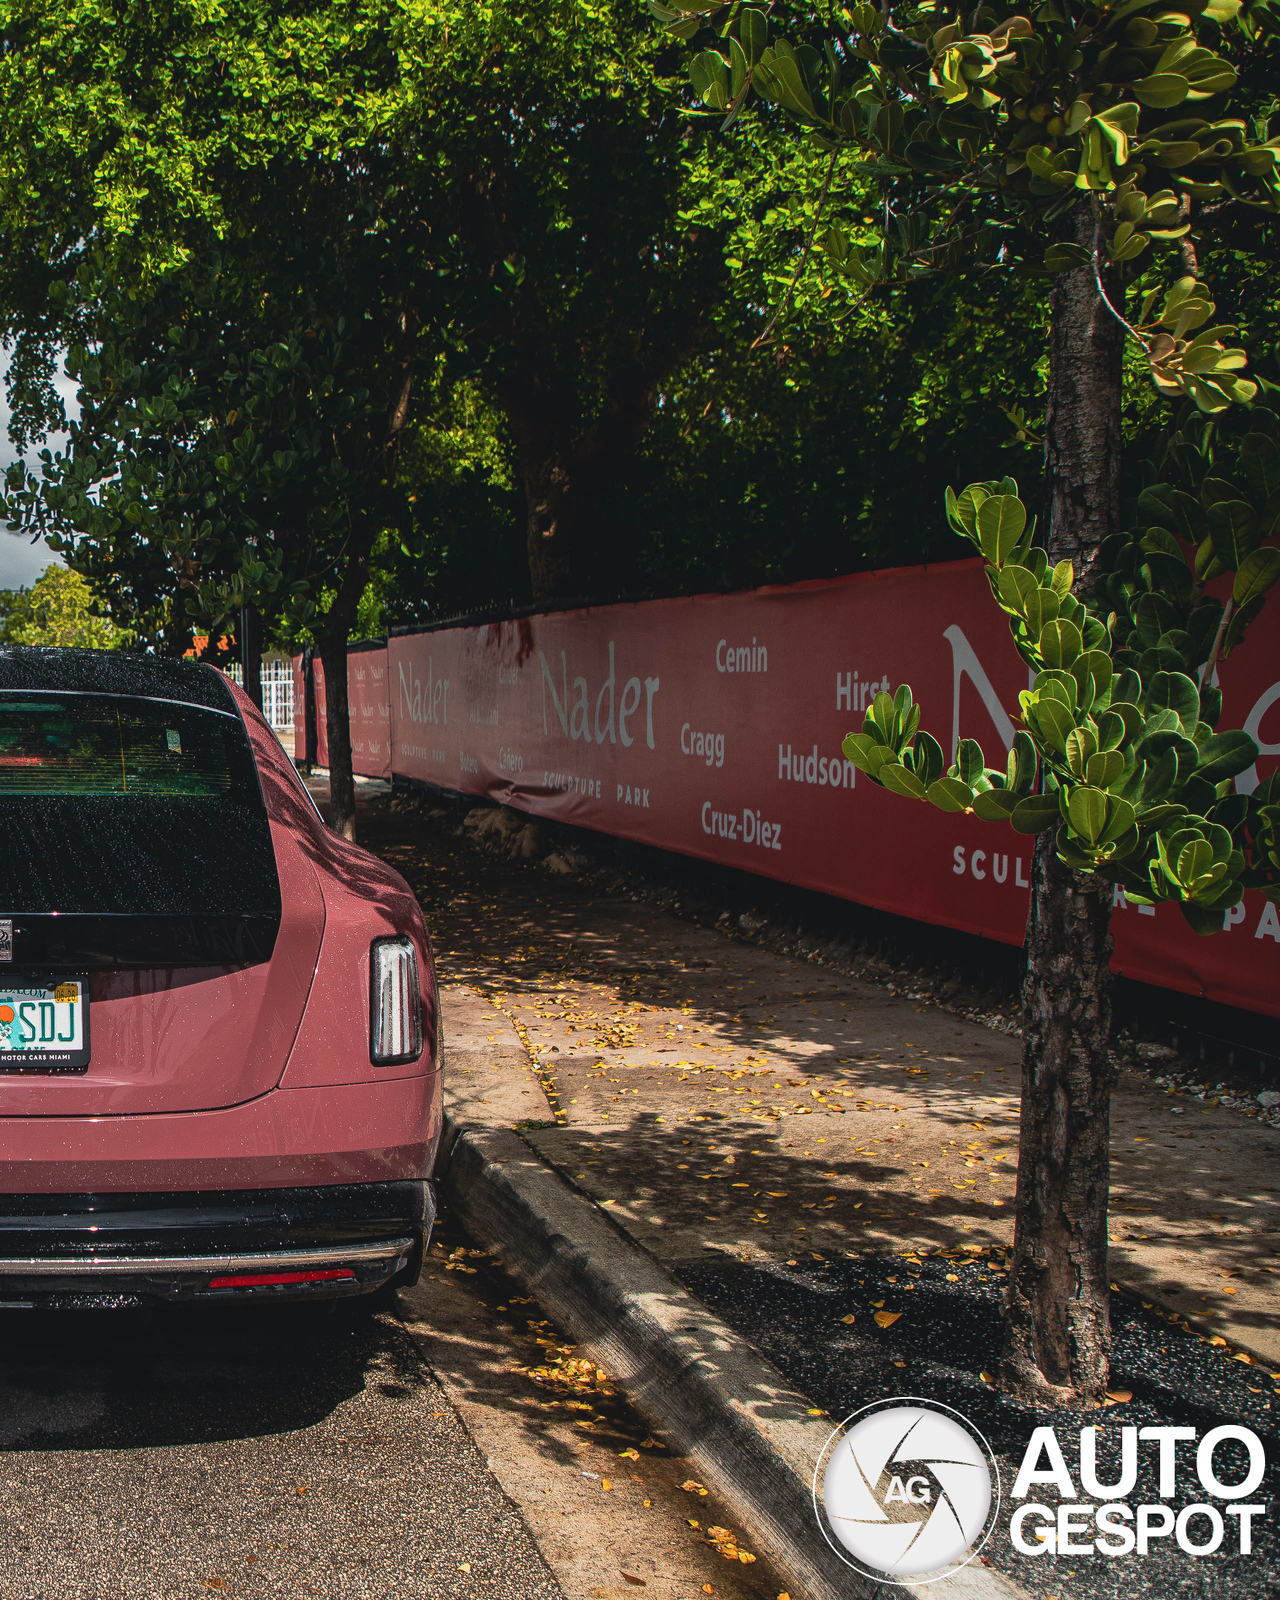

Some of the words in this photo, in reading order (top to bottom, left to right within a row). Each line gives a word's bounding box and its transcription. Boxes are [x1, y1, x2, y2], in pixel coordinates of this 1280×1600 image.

[716, 637, 768, 672] Cemin
[398, 655, 450, 725] Nader
[538, 641, 660, 750] Nader
[680, 723, 725, 767] Cragg
[778, 744, 856, 789] Hudson
[542, 771, 602, 799] SCULPTURE
[616, 784, 650, 808] PARK
[701, 801, 782, 850] Cruz-Diez
[19, 1002, 75, 1042] SDJ
[1, 1054, 26, 1062] MOTOR
